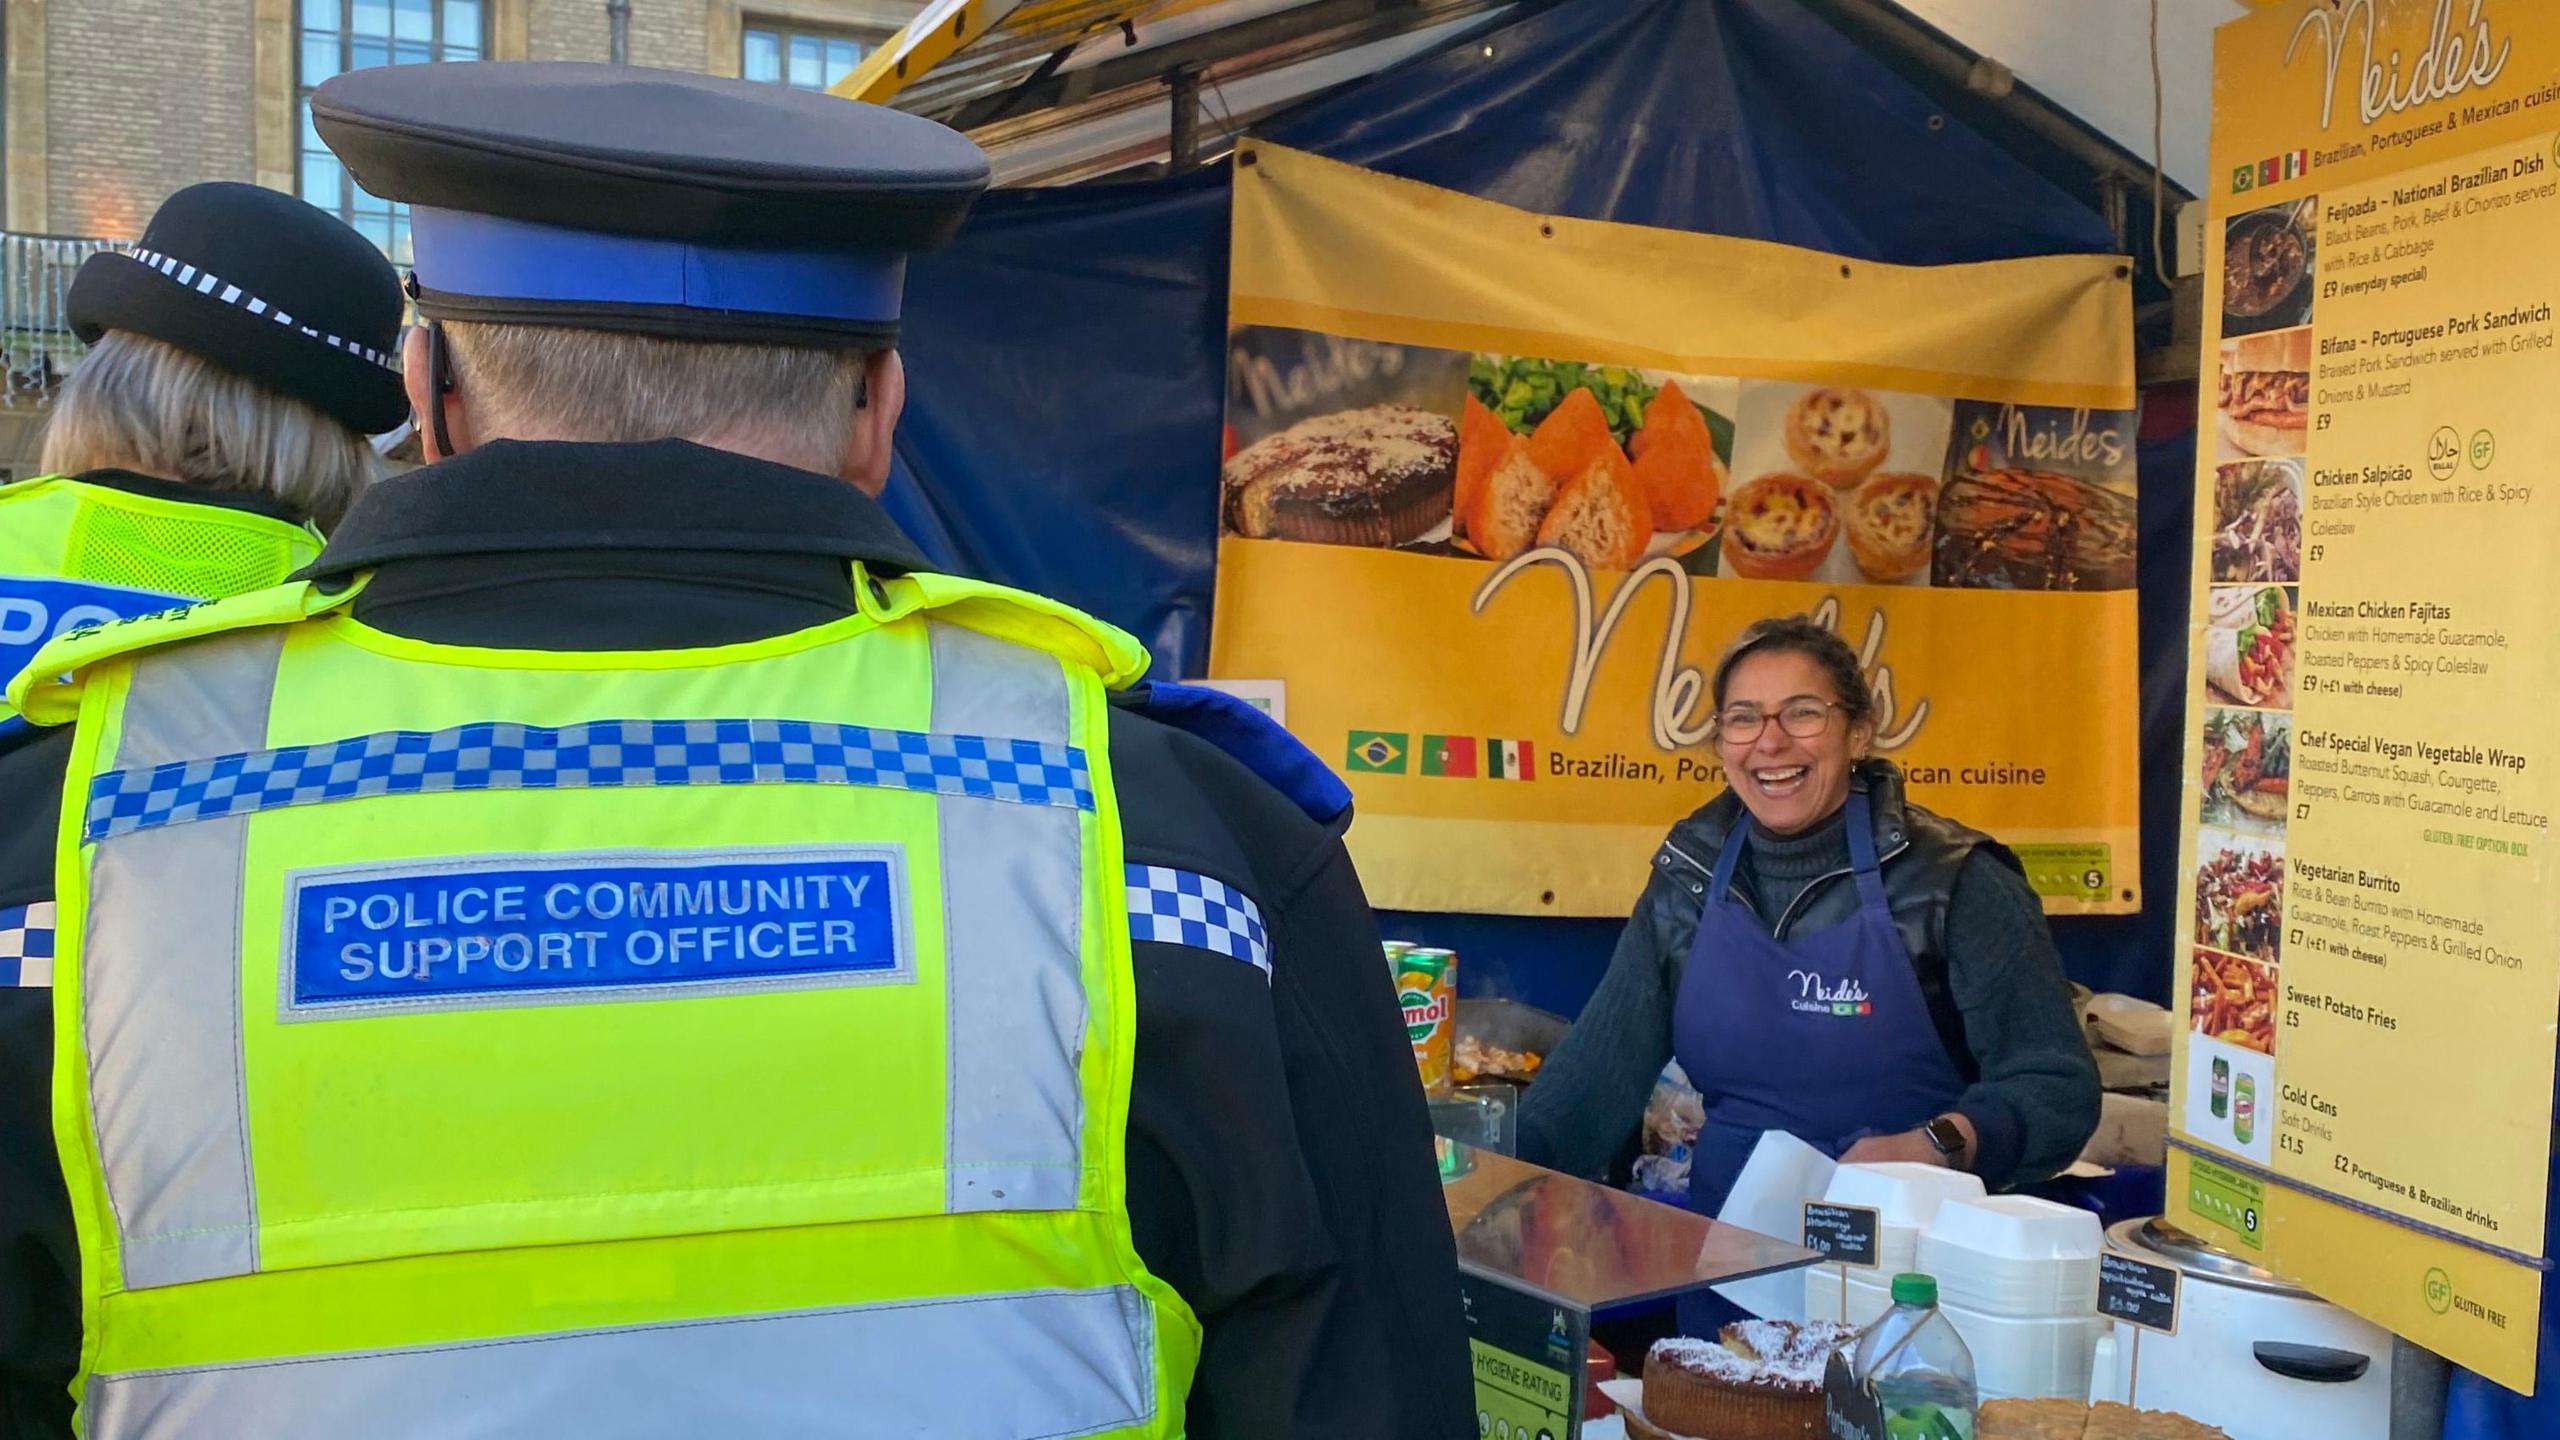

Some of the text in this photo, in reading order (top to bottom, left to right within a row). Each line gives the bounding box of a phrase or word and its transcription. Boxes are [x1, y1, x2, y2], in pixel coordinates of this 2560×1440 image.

[2314, 142, 2366, 167] Brazilian,
[2371, 122, 2442, 151] Portuguese
[2447, 112, 2457, 130] &
[2462, 98, 2519, 125] Mexican
[2327, 197, 2377, 224] Feijoada
[2393, 177, 2446, 207] National
[2451, 166, 2508, 192] Brazilian
[2512, 153, 2544, 178] Dish
[2325, 229, 2352, 246] Black
[2356, 220, 2390, 241] Beans,
[2423, 205, 2450, 224] Beef
[2453, 202, 2461, 218] &
[2466, 197, 2511, 216] Chorizo
[2514, 182, 2556, 205] served
[2324, 240, 2435, 272] with Rice & Cabbage
[2323, 267, 2428, 298] £9 (everyday special)
[2321, 336, 2356, 355] Bifana
[2372, 321, 2443, 348] Portuguese
[2448, 314, 2478, 336] Pork
[2483, 304, 2551, 330] Sandwich
[2319, 333, 2553, 379] Braised Pork Sandwich served with Grilled
[2318, 379, 2411, 404] Onions & Mustard
[2317, 414, 2331, 430] £9
[2474, 441, 2490, 459] GF
[2314, 464, 2412, 487] Chicken Salpicão
[2312, 483, 2532, 512] Brazilian Style Chicken with Rice & Spicy
[2311, 520, 2355, 536] Coleslaw
[2310, 546, 2324, 561] £9
[2307, 602, 2450, 623] Mexican Chicken Fajitas
[2305, 626, 2508, 649] Chicken with Homemade Guacamole,
[2304, 652, 2488, 675] Roasted Peppers & Spicy Coleslaw
[2304, 676, 2403, 699] £9 (+£1 with cheese)
[2300, 731, 2526, 774] Chef Special Vegan Vegetable Wrap
[1549, 753, 1665, 782] Brazilian,
[1962, 762, 2046, 784] cuisine
[2299, 756, 2502, 796] Roasted Butternut Squash, Courgette,
[2296, 804, 2310, 820] £7
[2298, 781, 2548, 829] Peppers, Carrots with Guacamole and Lettuce
[2088, 872, 2099, 887] 5
[2294, 859, 2401, 893] Vegetarian Burrito
[325, 874, 871, 934] POLICE COMMUNITY
[2292, 884, 2484, 936] Rice & Bean Burrito with Homemade
[340, 921, 857, 980] SUPPORT OFFICER
[2290, 930, 2387, 968] £7 (+£1 with cheese)
[2291, 906, 2523, 970] Guacamole, Roast Peppers & Grilled Onion
[1788, 970, 1868, 1001] Neide's
[1792, 1000, 1830, 1013] Cuisine
[2286, 1010, 2299, 1028] £5
[2287, 986, 2397, 1030] Sweet Potato Fries
[2282, 1085, 2338, 1118] Cold Cans
[2281, 1109, 2332, 1141] Soft Drinks
[2281, 1134, 2304, 1155] £1.5
[2335, 1155, 2499, 1231] £2 Portuguese & Brazilian drinks
[2247, 1210, 2254, 1229] 5
[2428, 1280, 2448, 1301] GF
[2453, 1295, 2507, 1329] GLUTEN FREE
[1477, 1355, 1562, 1401] HYGIENE RATING
